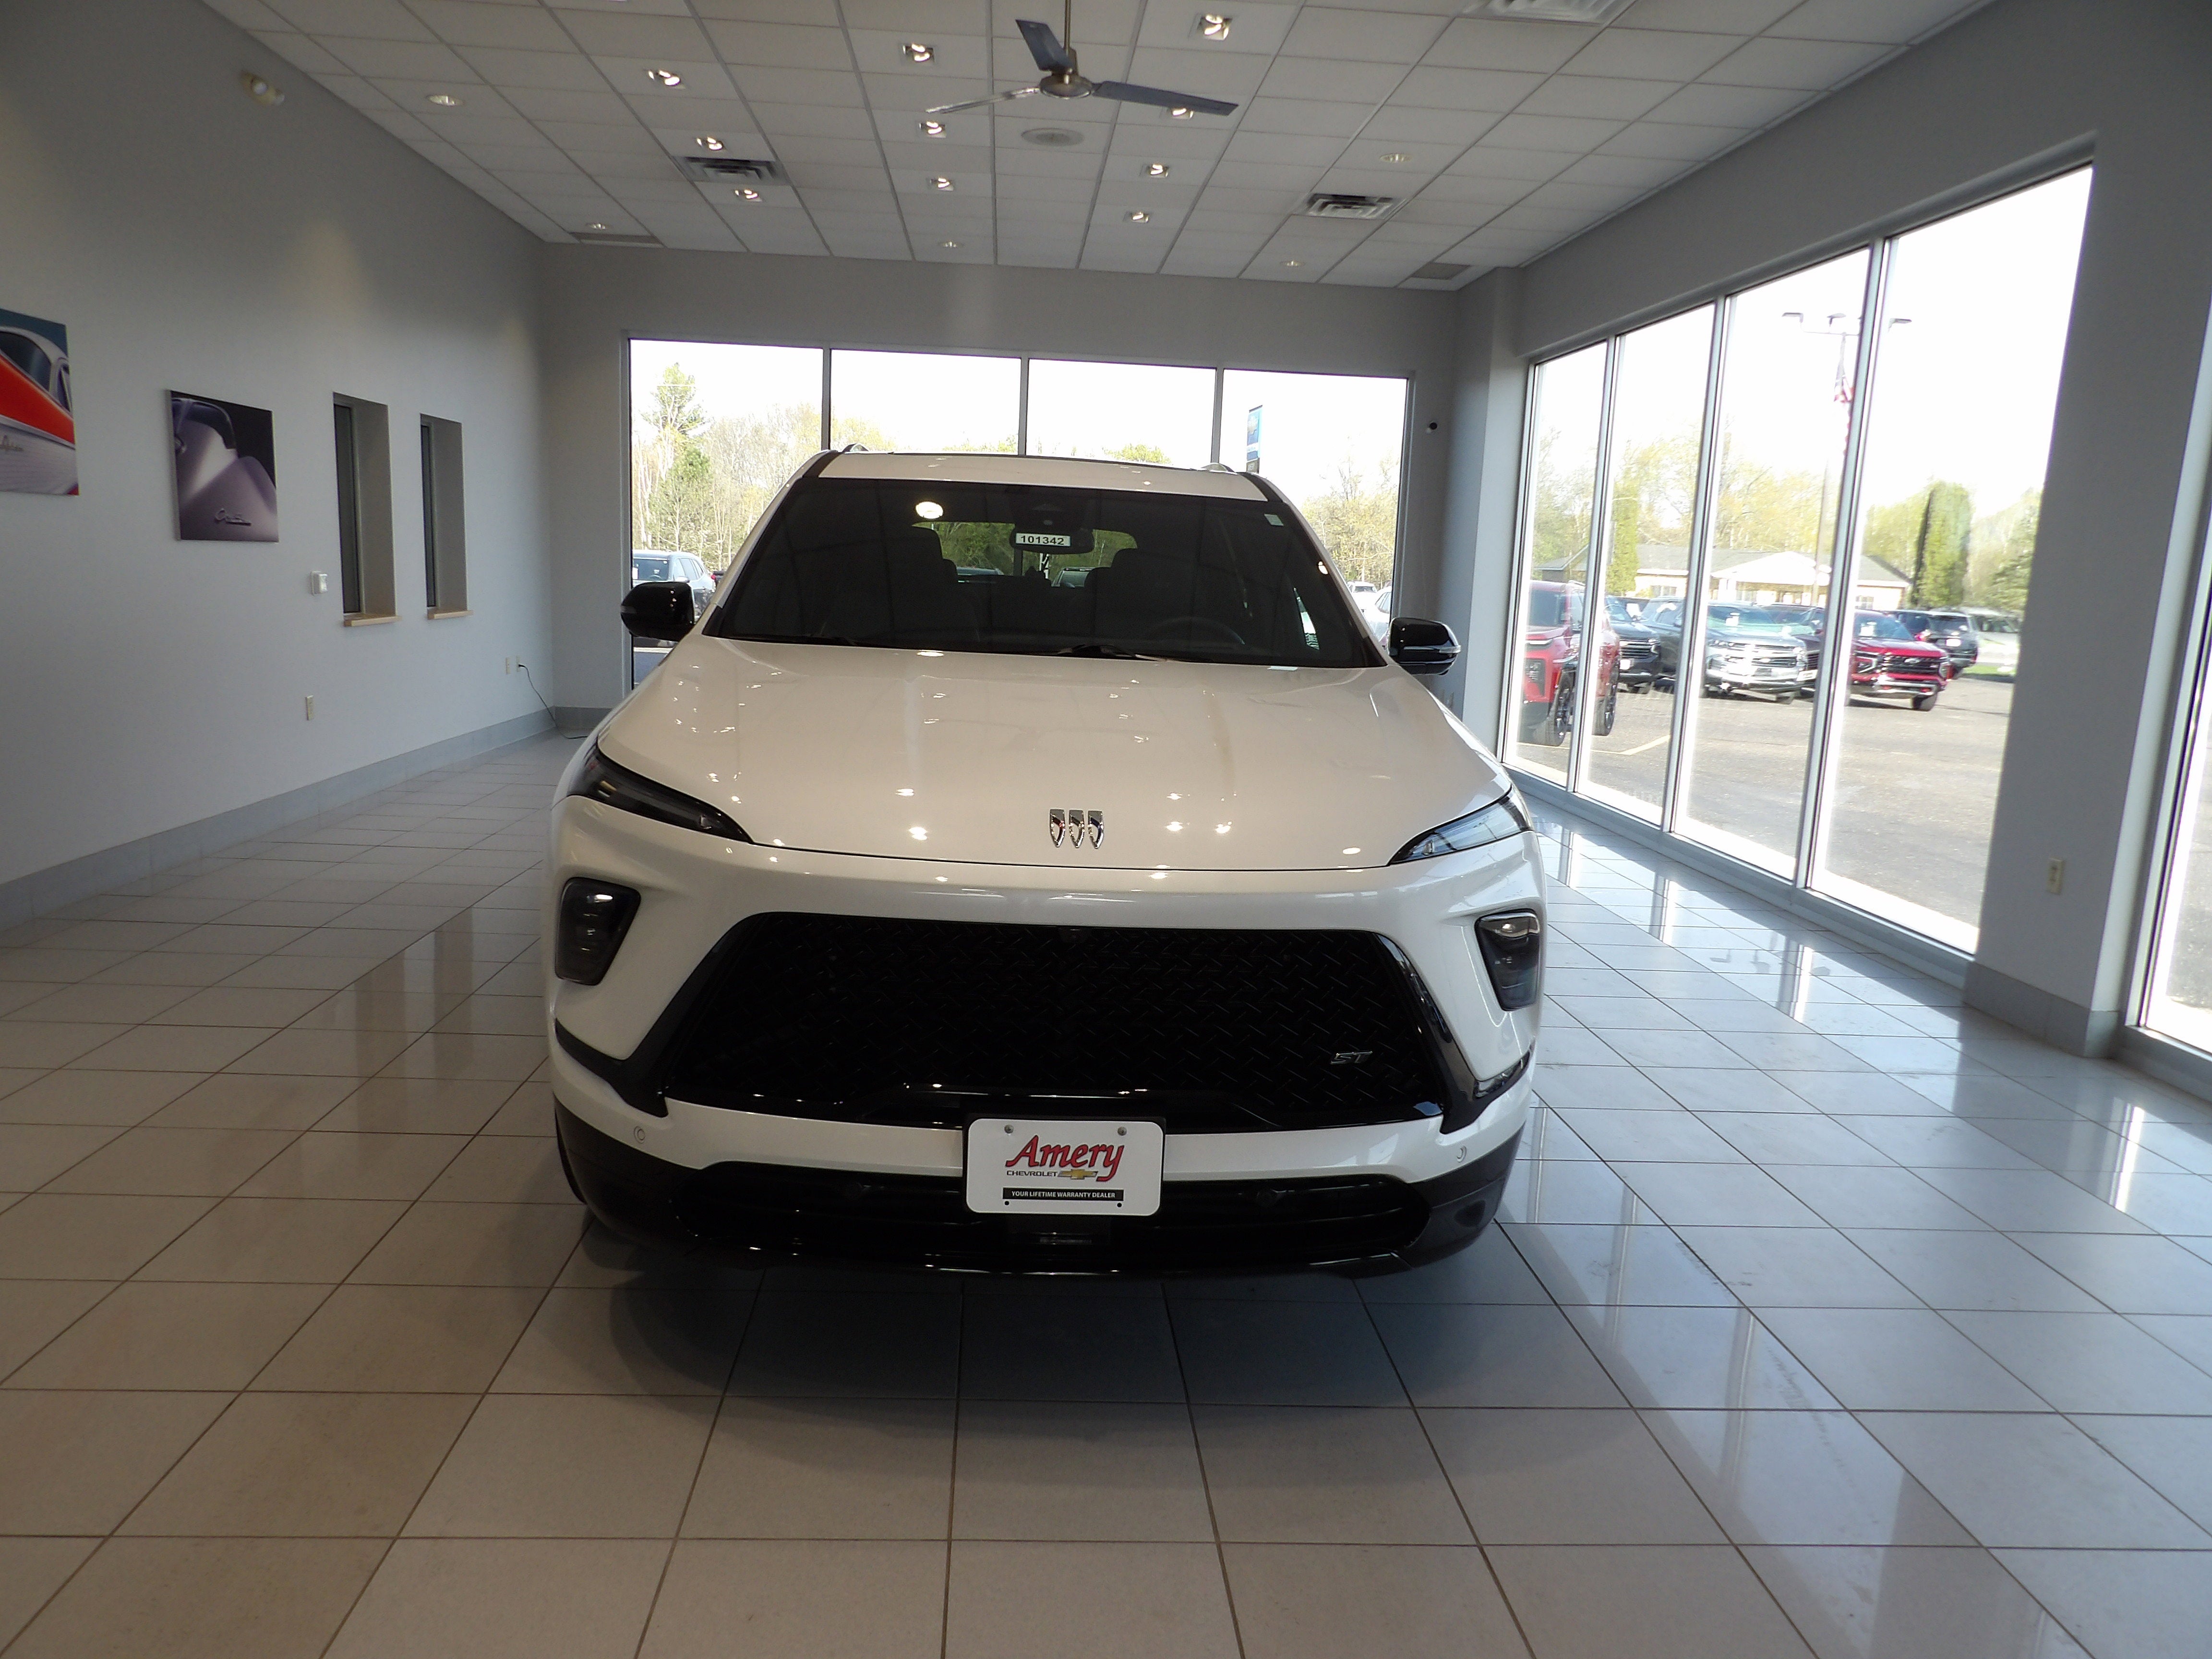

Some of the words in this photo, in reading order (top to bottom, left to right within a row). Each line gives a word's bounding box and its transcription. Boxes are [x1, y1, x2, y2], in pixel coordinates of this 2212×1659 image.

[1021, 535, 1064, 545] 101342
[1330, 1050, 1373, 1065] ST
[1005, 1134, 1124, 1182] Amery
